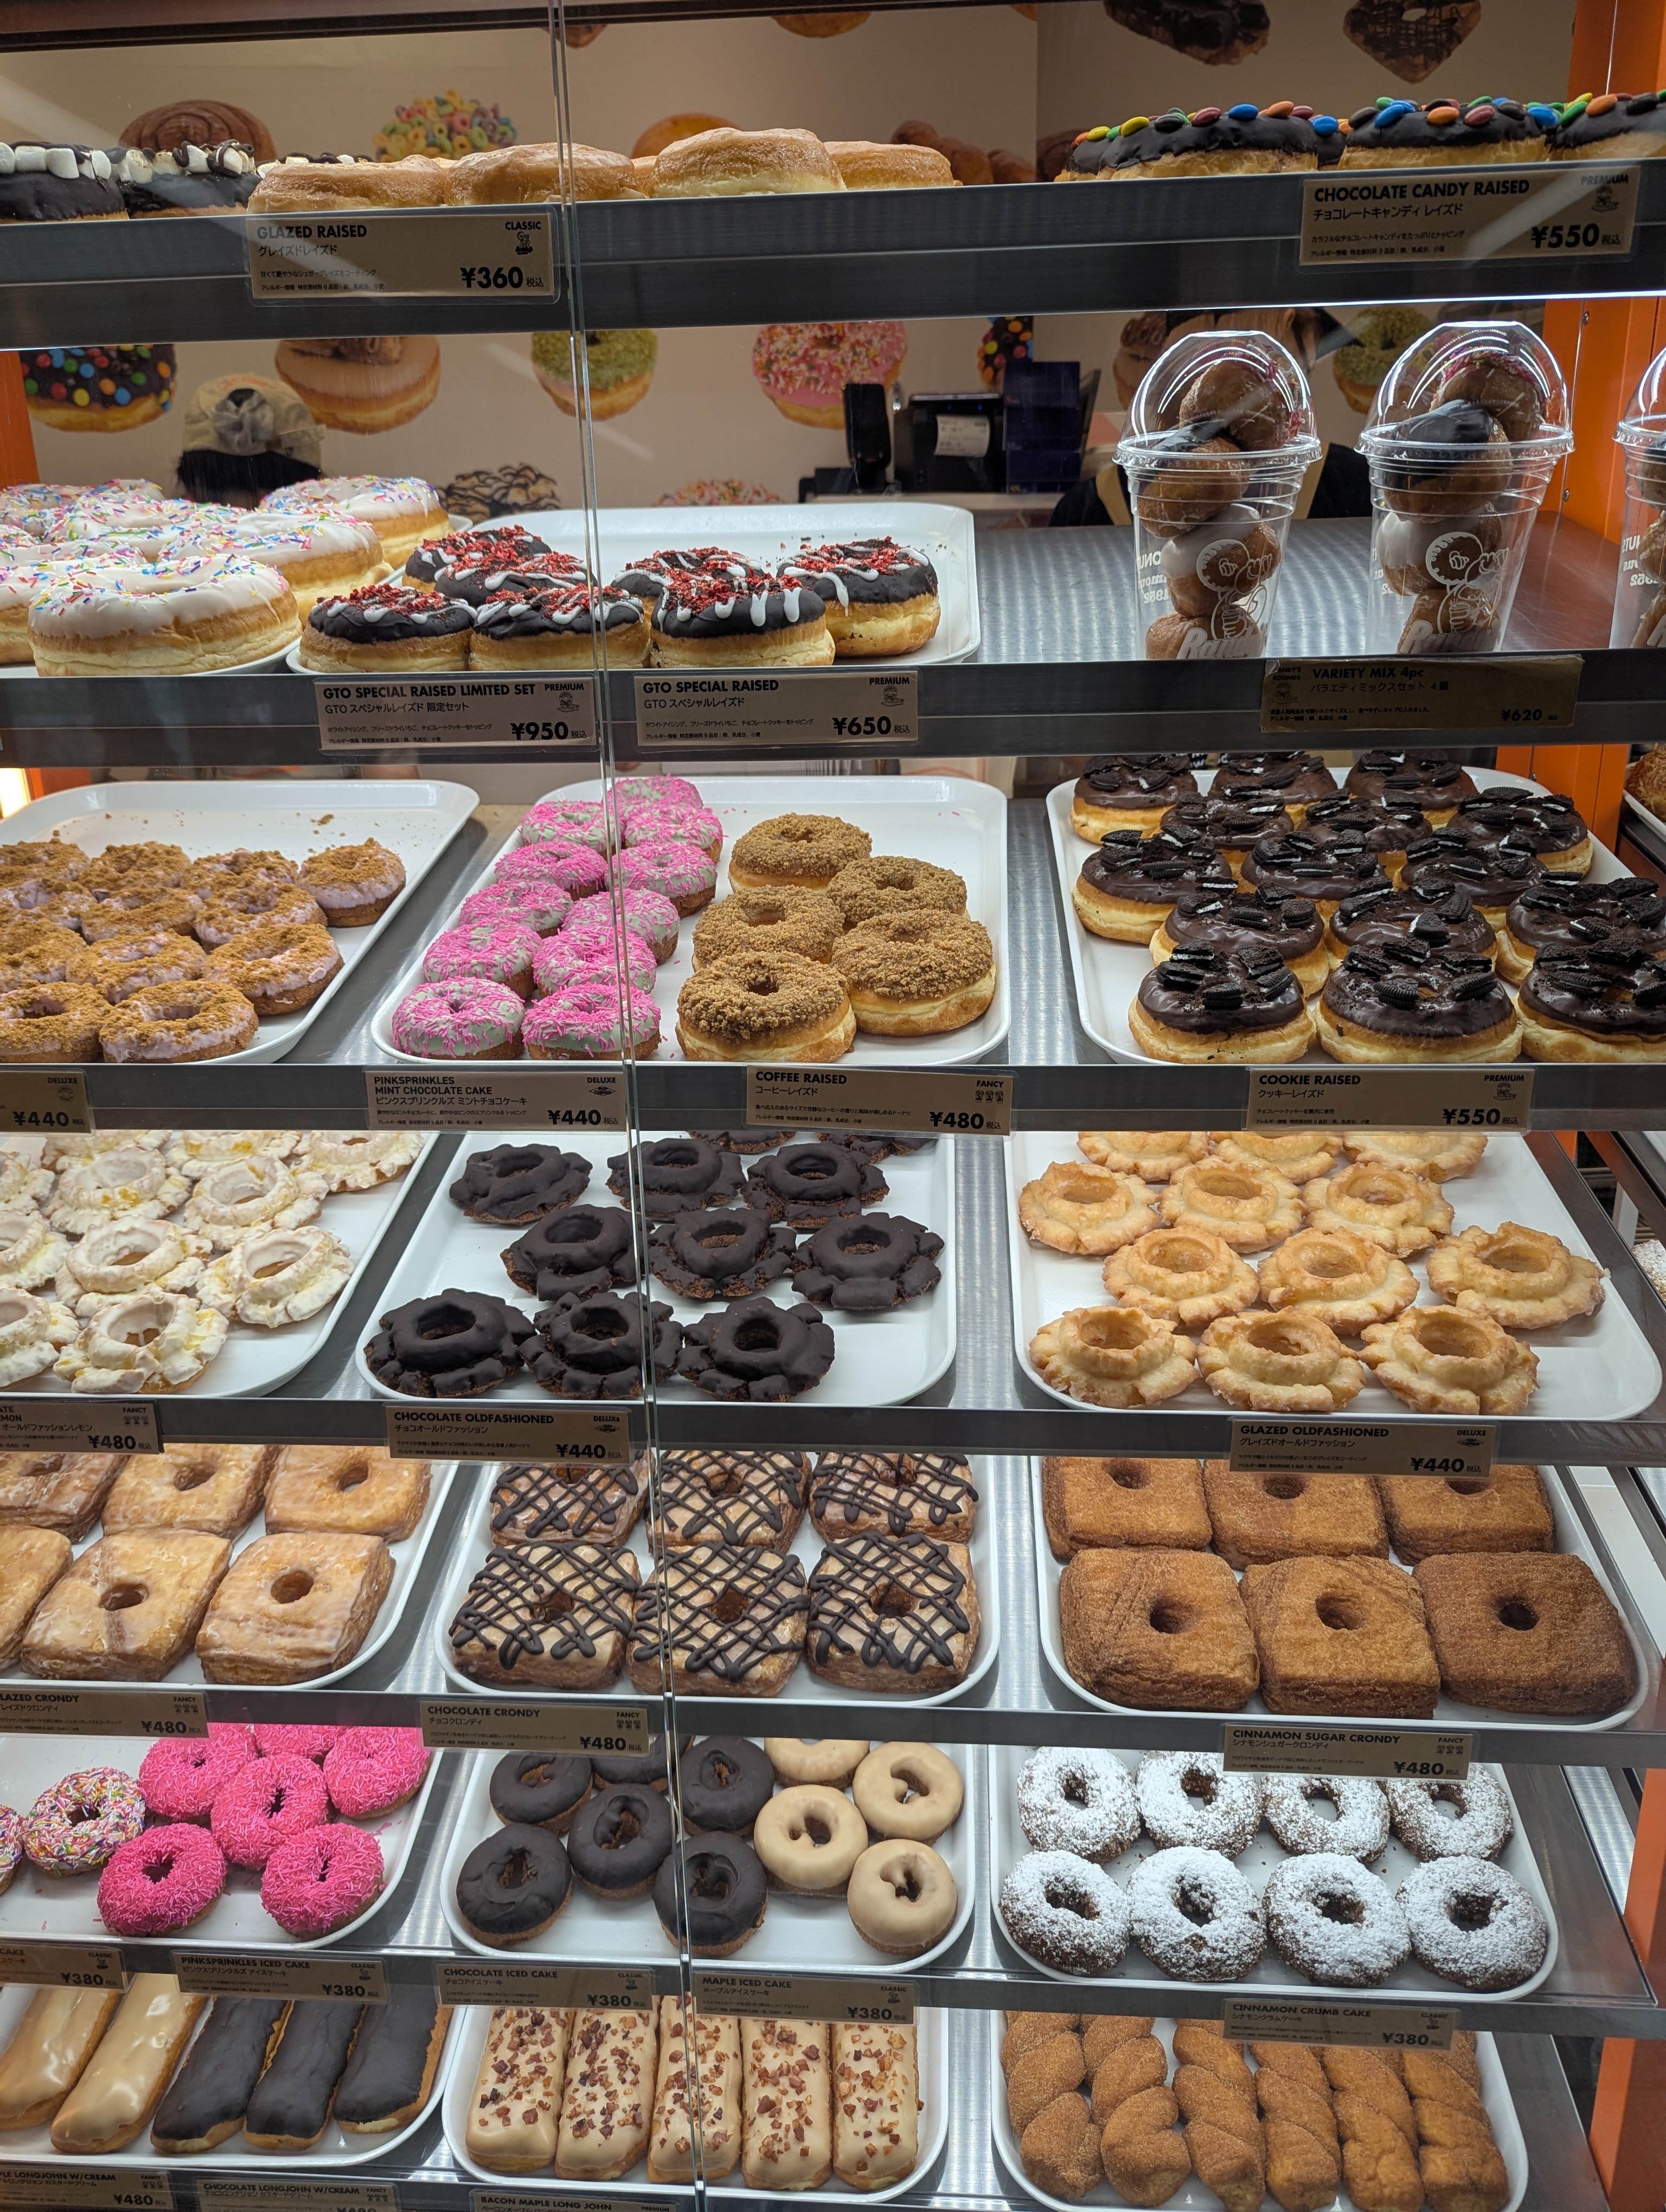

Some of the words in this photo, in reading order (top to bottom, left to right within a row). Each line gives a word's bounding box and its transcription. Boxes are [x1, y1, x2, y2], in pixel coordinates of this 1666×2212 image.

[1580, 174, 1629, 185] PREMIUM
[1315, 184, 1407, 202] CHOCOLATE
[1412, 182, 1469, 198] CANDY
[1473, 179, 1530, 196] RAISED
[257, 226, 313, 239] GLAZED
[317, 224, 367, 238] RAISED
[505, 221, 542, 230] CLASSIC
[1531, 223, 1600, 248] ¥550
[259, 244, 338, 257] グレイズドレイズド
[460, 266, 523, 288] ¥360
[526, 276, 544, 287] 税込
[1312, 668, 1366, 679] VARIETY
[1369, 667, 1396, 678] MIX
[1400, 666, 1424, 680] 4pc
[323, 687, 351, 699] GTO
[356, 686, 407, 698] SPECIAL
[411, 685, 456, 697] RAISED
[460, 684, 509, 696] LIMITED
[514, 684, 535, 695] SET
[544, 683, 584, 691] PREMIUM
[643, 682, 671, 693] GTO
[676, 681, 728, 692] SPECIAL
[732, 679, 779, 691] RAISED
[325, 704, 348, 714] GTO
[350, 703, 424, 713] スペシャルレイズド
[427, 702, 469, 712] 限定セット
[644, 699, 667, 709] GTO
[669, 697, 745, 708] スペシャルレイズド
[1501, 709, 1543, 722] ¥620
[510, 722, 568, 740] ¥950
[571, 730, 587, 738] 税込
[832, 716, 891, 735] ¥650
[894, 725, 910, 733] 税込
[374, 1076, 455, 1084] PINKSPRINKLES
[755, 1071, 799, 1082] COFFEE
[804, 1073, 847, 1084] RAISED
[1259, 1075, 1310, 1085] COOKIE
[1314, 1075, 1361, 1085] RAISED
[375, 1086, 400, 1095] MINT
[403, 1086, 463, 1095] CHOCOLATE
[465, 1086, 492, 1095] CAKE
[755, 1086, 818, 1096] コーヒーレイズド
[1258, 1089, 1324, 1098] クッキーレイズド
[376, 1097, 455, 1105] ピンクスプリンクルズ
[458, 1097, 528, 1105] ミントチョコケーキ
[12, 1111, 69, 1127] ¥440
[547, 1109, 601, 1126] ¥440
[603, 1117, 619, 1125] 税込
[929, 1111, 984, 1129] ¥480
[986, 1121, 1001, 1129] 税込
[1443, 1108, 1501, 1125] ¥550
[394, 1412, 462, 1422] CHOCOLATE
[465, 1413, 554, 1424] OLDFASHIONED
[395, 1424, 488, 1433] チョコオールドファッション
[1240, 1425, 1289, 1435] GLAZED
[1292, 1426, 1389, 1437] OLDFASHIONED
[88, 1435, 136, 1450] ¥480
[1240, 1438, 1355, 1448] グレイズドオールドファッション
[555, 1444, 606, 1458] ¥440
[1411, 1457, 1465, 1472] ¥440
[0, 1693, 32, 1701] LAZED
[35, 1694, 79, 1702] CRONDY
[427, 1706, 491, 1715] CHOCOLATE
[494, 1708, 540, 1718] CRONDY
[140, 1720, 187, 1733] ¥480
[428, 1717, 482, 1725] チョコクロンディ
[1233, 1729, 1301, 1740] CINNAMON
[1305, 1732, 1347, 1741] SUGAR
[1349, 1734, 1401, 1744] CRONDY
[579, 1737, 626, 1750] ¥480
[1232, 1739, 1329, 1750] シナモンシュガークロンディ
[1393, 1761, 1444, 1775] ¥480
[181, 1957, 257, 1966] PINKSPRINKLES
[284, 1961, 311, 1969] CAKE
[60, 1972, 104, 1985] ¥380
[444, 1969, 503, 1977] CHOCOLATE
[702, 1977, 736, 1985] MAPLE
[765, 1980, 792, 1989] CAKE
[322, 1984, 366, 1997] ¥380
[587, 1995, 631, 2007] ¥380
[847, 2007, 892, 2020] ¥380
[1233, 2004, 1297, 2014] CINNAMON
[1300, 2007, 1339, 2015] CRUMB
[1383, 2033, 1430, 2046] ¥380
[113, 2194, 153, 2205] ¥480
[480, 2196, 516, 2204] BACON
